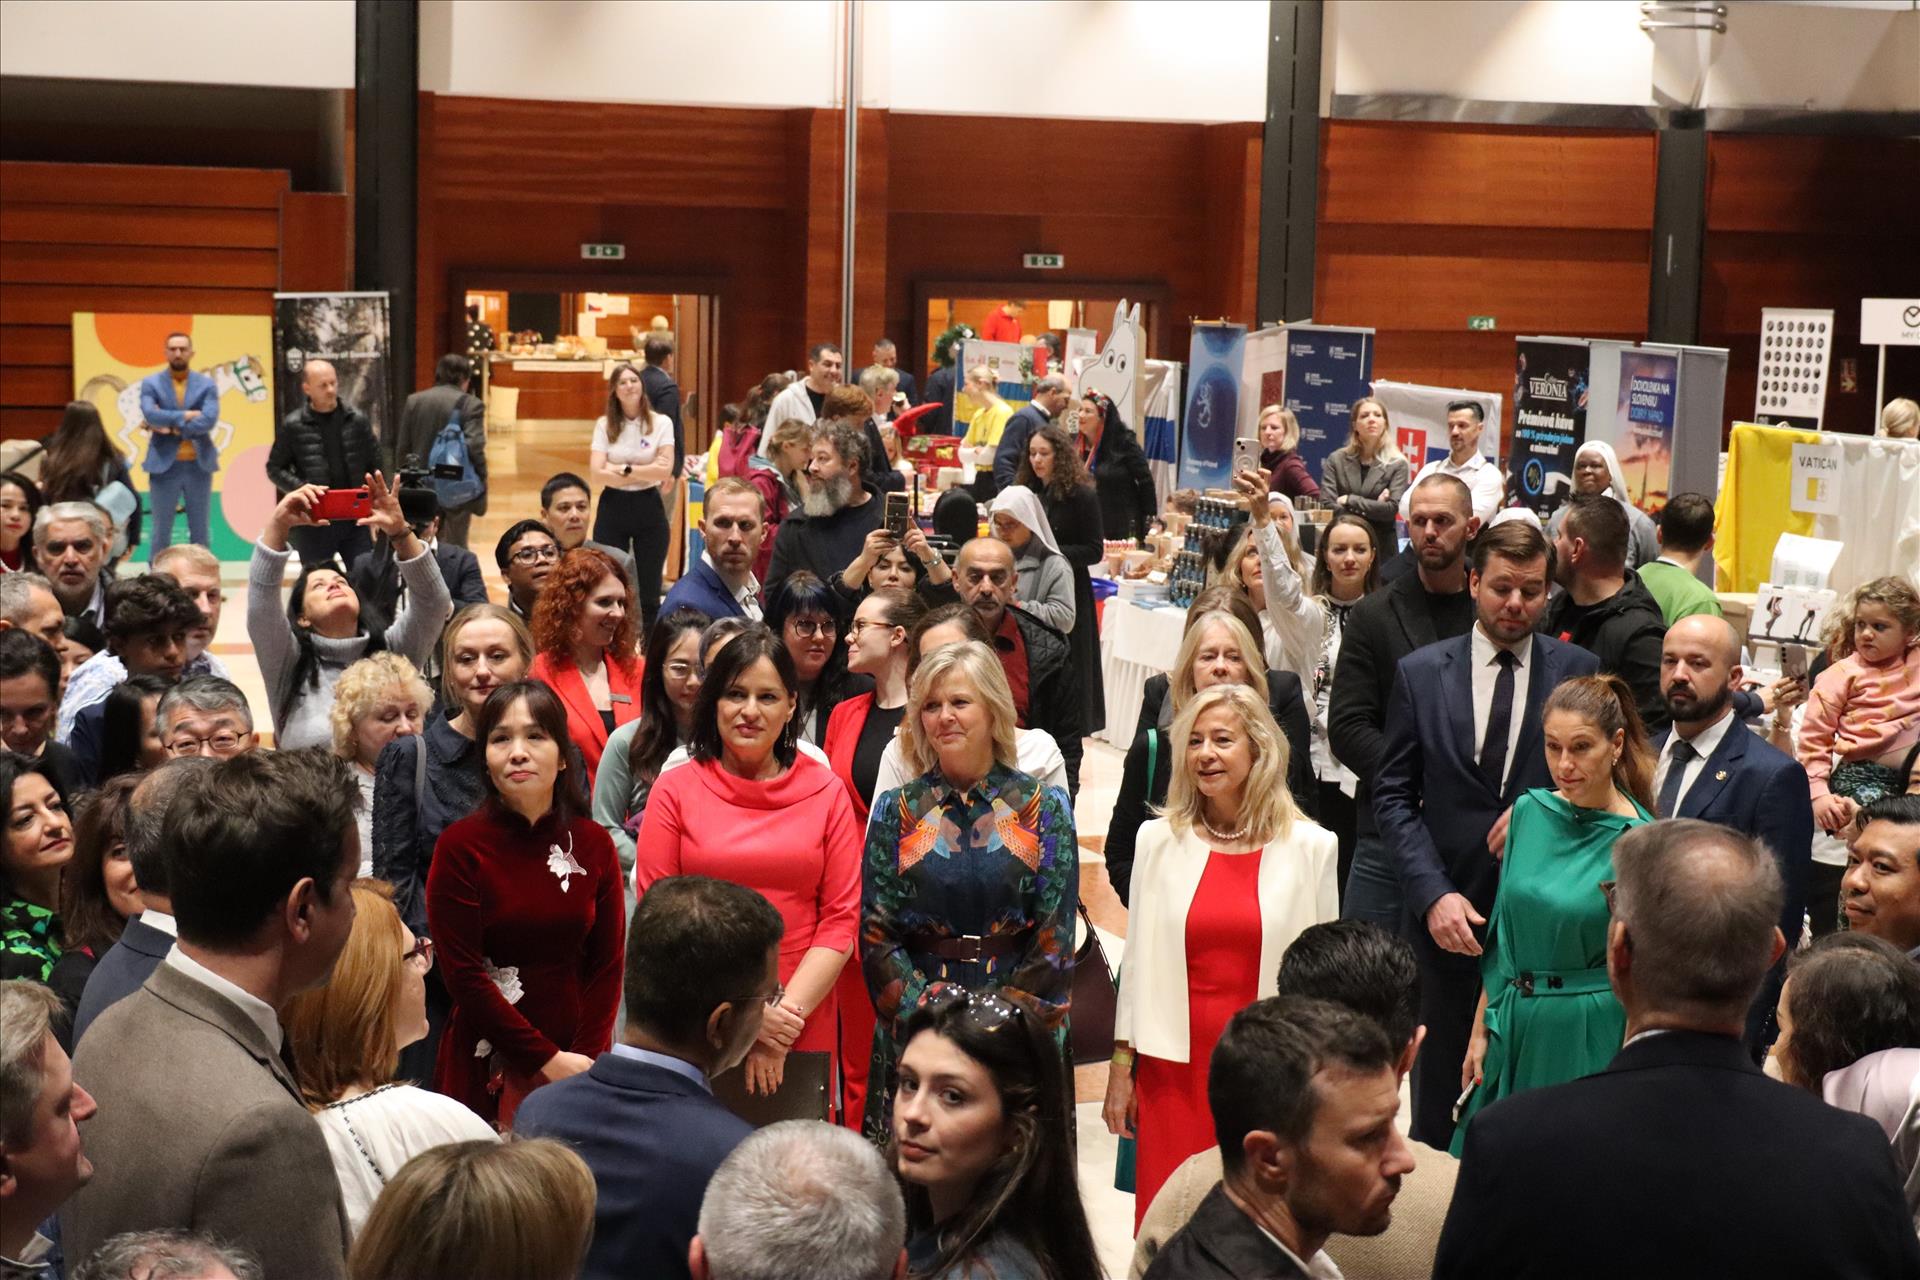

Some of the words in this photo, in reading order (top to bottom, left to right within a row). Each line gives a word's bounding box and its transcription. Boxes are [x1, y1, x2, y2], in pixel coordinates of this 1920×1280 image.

[1529, 381, 1567, 397] VERONIA
[1518, 409, 1555, 428] Prémiová
[1555, 412, 1574, 431] káva
[1799, 456, 1838, 470] VATICAN
